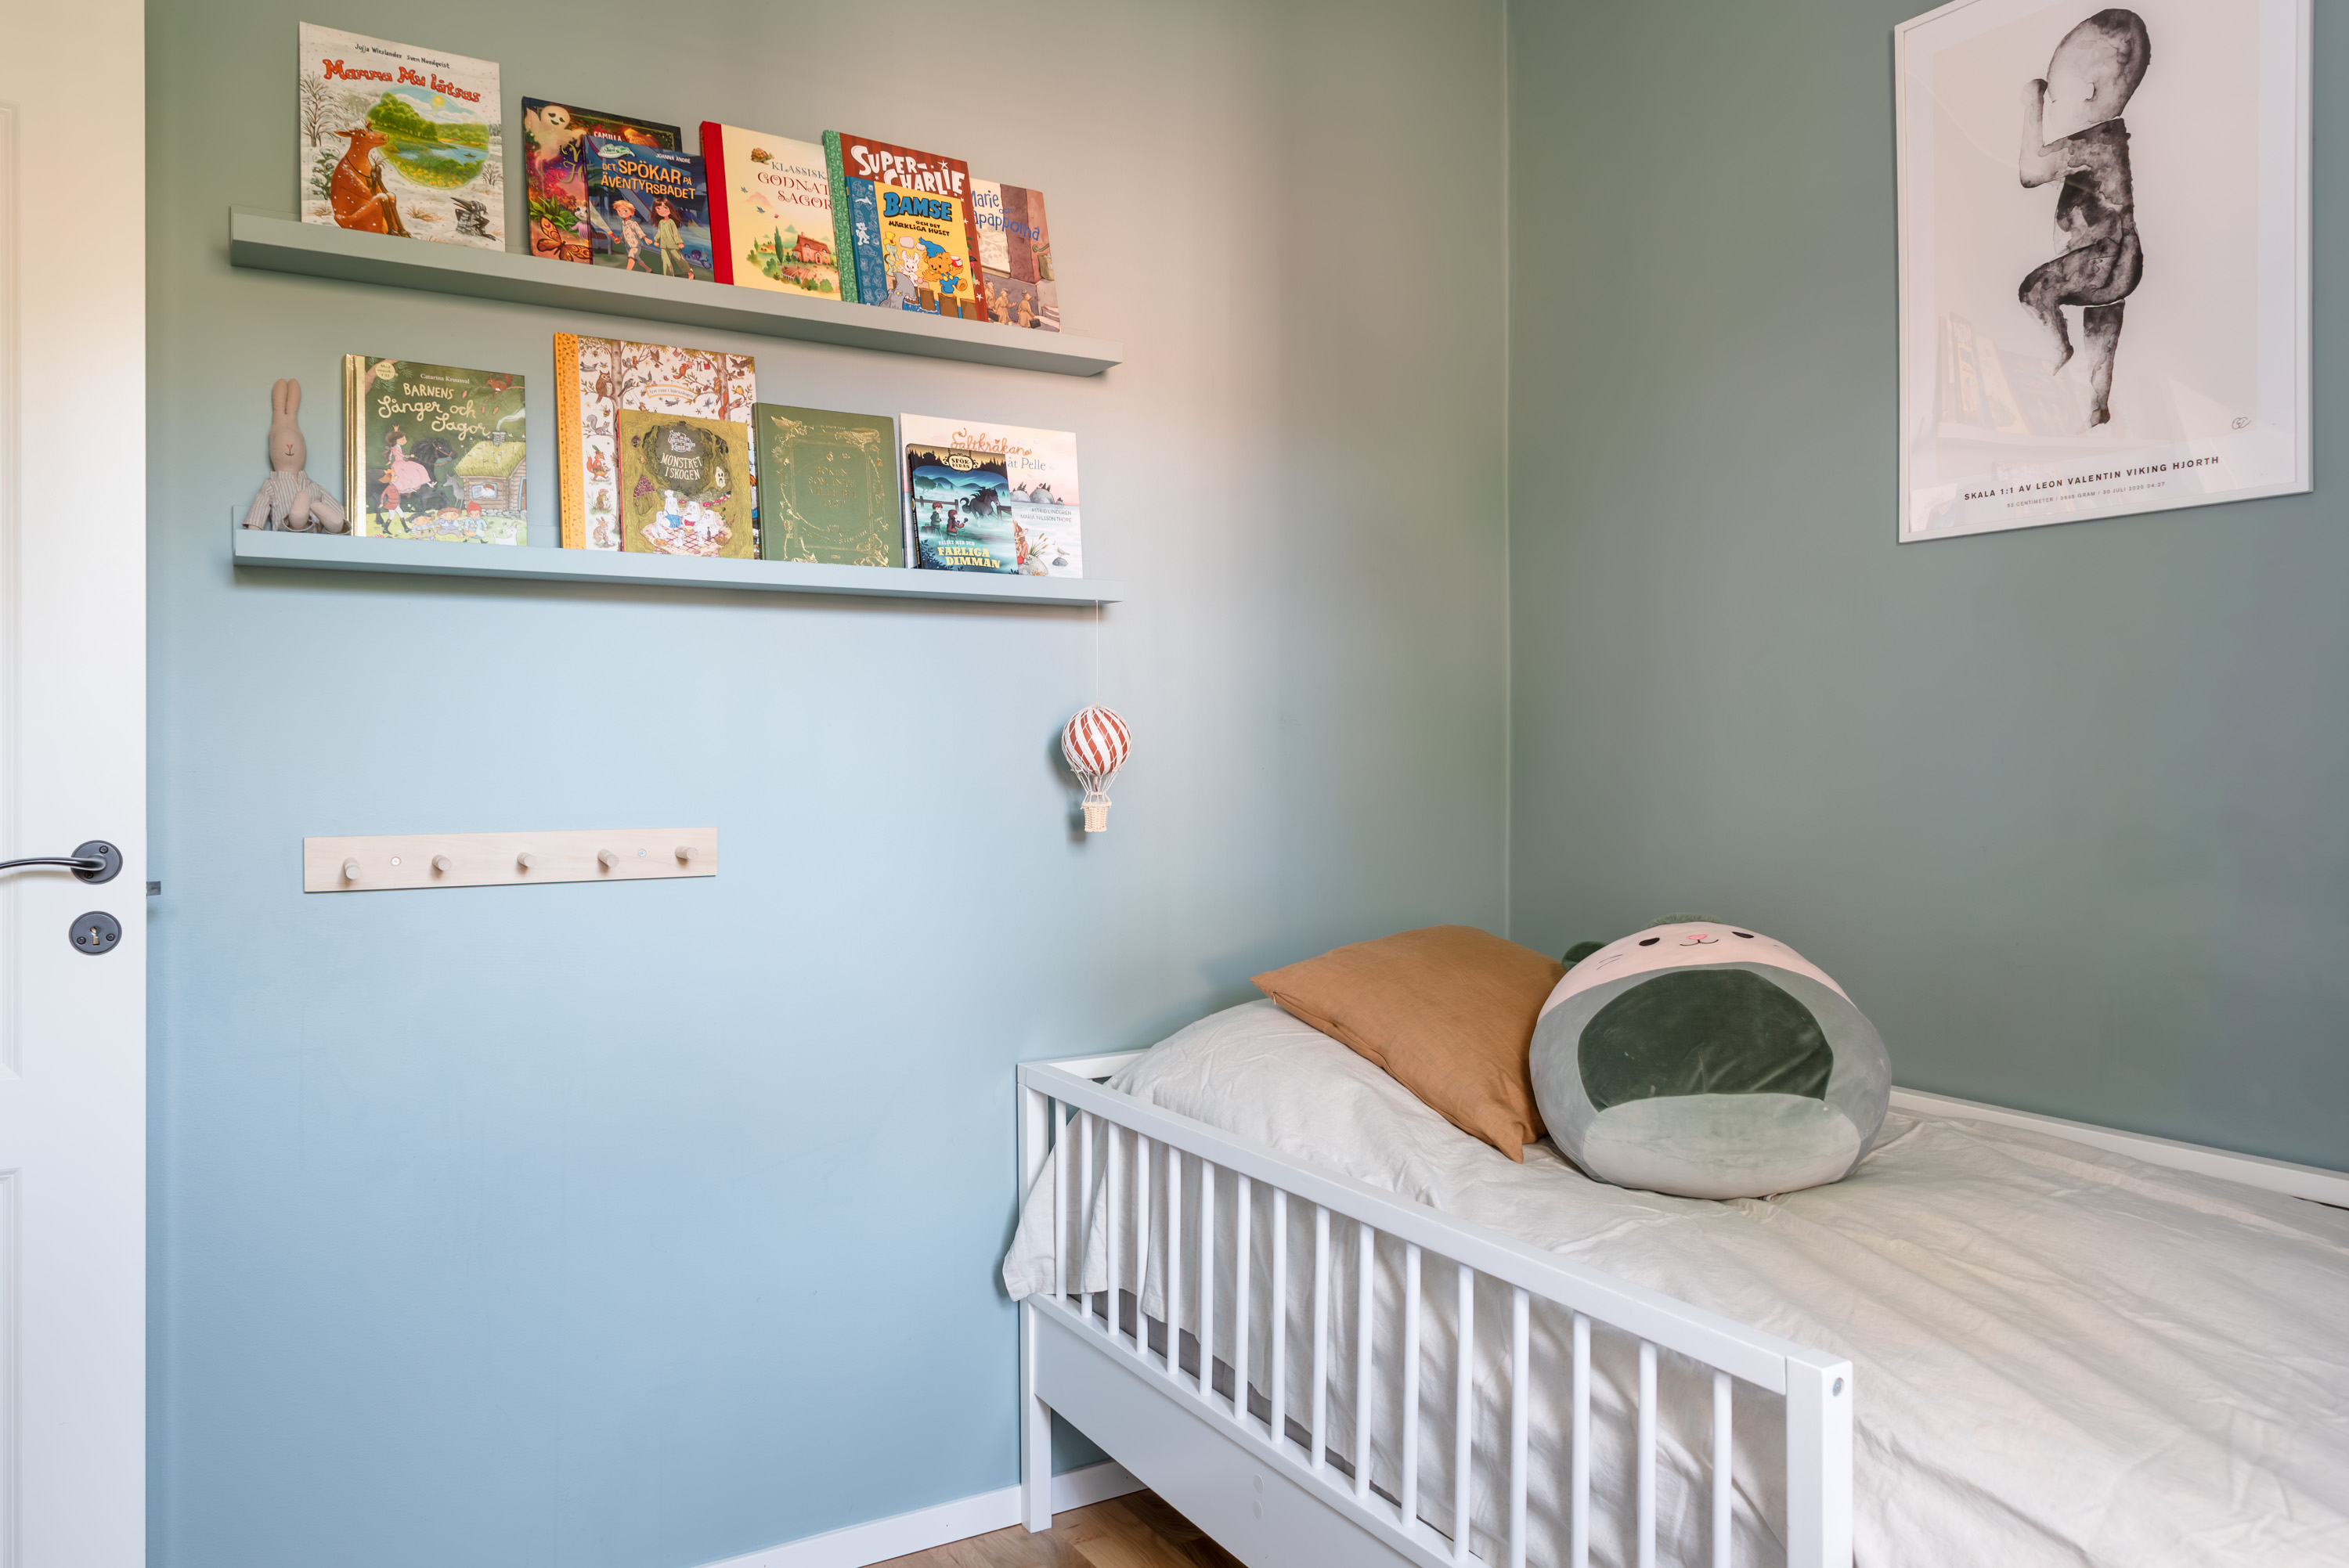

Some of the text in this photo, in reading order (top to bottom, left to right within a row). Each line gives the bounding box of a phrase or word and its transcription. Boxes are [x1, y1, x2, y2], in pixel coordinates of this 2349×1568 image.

[355, 44, 370, 53] Jujja
[371, 47, 402, 59] Wieslander
[421, 58, 450, 69] Nordqvist
[322, 59, 481, 103] Mamma Mu låtsas
[655, 153, 675, 161] JOANNA
[850, 145, 928, 176] SUPER-
[601, 160, 692, 186] DET SPÖKAR PÅ
[883, 168, 965, 195] CHARLIE
[601, 171, 696, 200] ÄVENTYRSBADET
[778, 190, 832, 211] SAGOR
[882, 191, 953, 222] BAMSE
[928, 228, 950, 236] HUSET
[420, 373, 471, 384] Catarina Kruusval
[403, 382, 455, 400] BARNENS
[377, 395, 477, 422] Sånger och
[431, 413, 492, 441] Sagor
[951, 427, 1033, 456] Saltkråkan
[660, 452, 702, 470] MONSTRET
[1021, 457, 1046, 470] Pelle
[665, 467, 701, 480] I SKOGEN
[1964, 456, 2220, 501] SKALA 1:1 AV LEON VALENTIN VIKING HJORTH
[2015, 497, 2054, 506] CENTIMETER
[936, 546, 990, 557] FARLIGA
[945, 556, 1001, 569] DIMMAN
